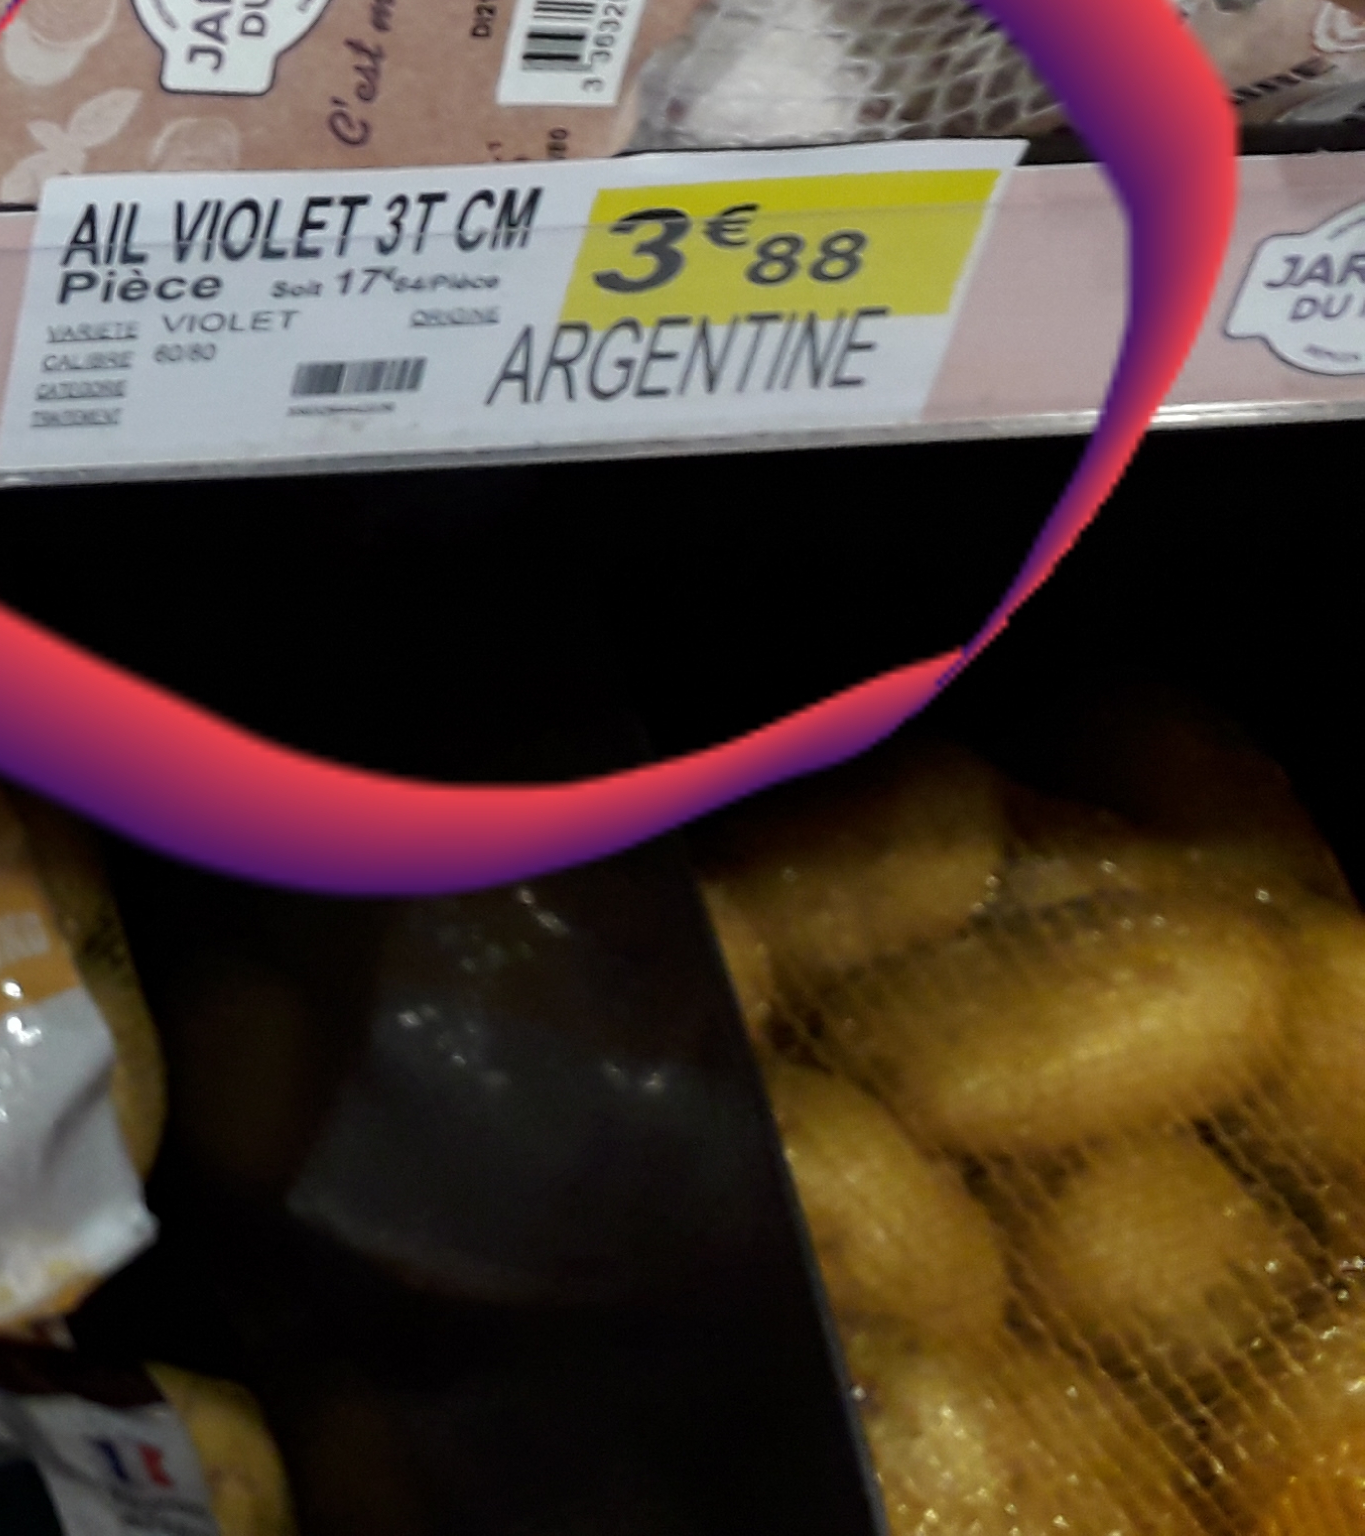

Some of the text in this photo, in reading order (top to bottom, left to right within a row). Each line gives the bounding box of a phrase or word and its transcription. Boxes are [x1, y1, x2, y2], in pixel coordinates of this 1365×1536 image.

[327, 38, 385, 148] C'est
[60, 186, 546, 266] AIL VIOLET 3T CM
[55, 269, 224, 305] Pièce
[271, 279, 324, 299] Soit
[1286, 293, 1355, 323] DU
[160, 309, 301, 333] VIOLET
[483, 305, 891, 407] ARGENTINE
